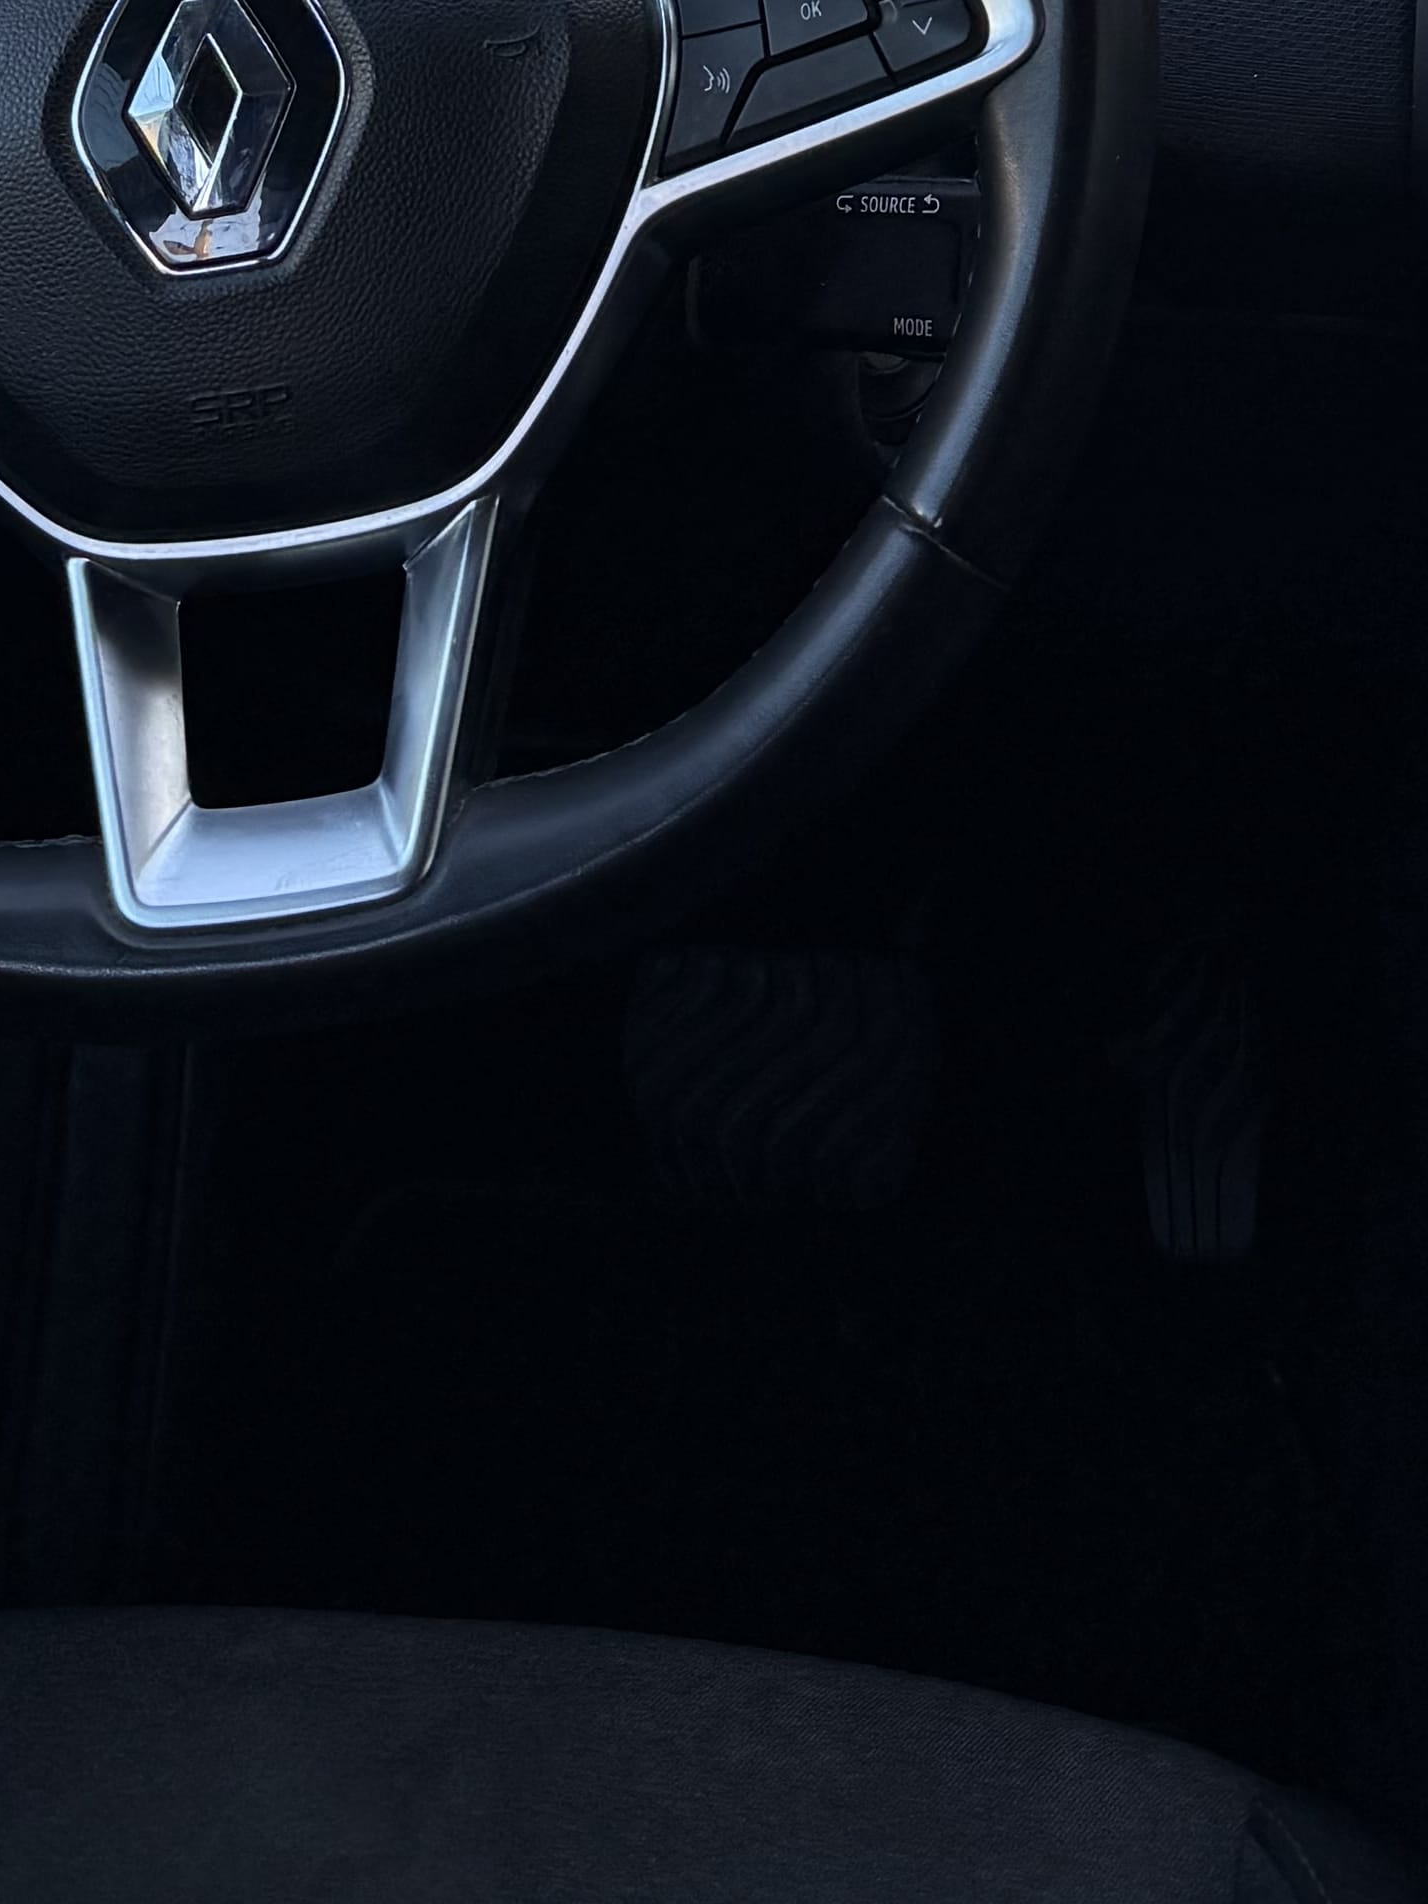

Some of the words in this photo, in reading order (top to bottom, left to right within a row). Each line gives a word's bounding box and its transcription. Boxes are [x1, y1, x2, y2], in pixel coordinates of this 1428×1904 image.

[799, 0, 822, 21] OK
[859, 194, 917, 214] SOURCE
[892, 316, 933, 337] MODE
